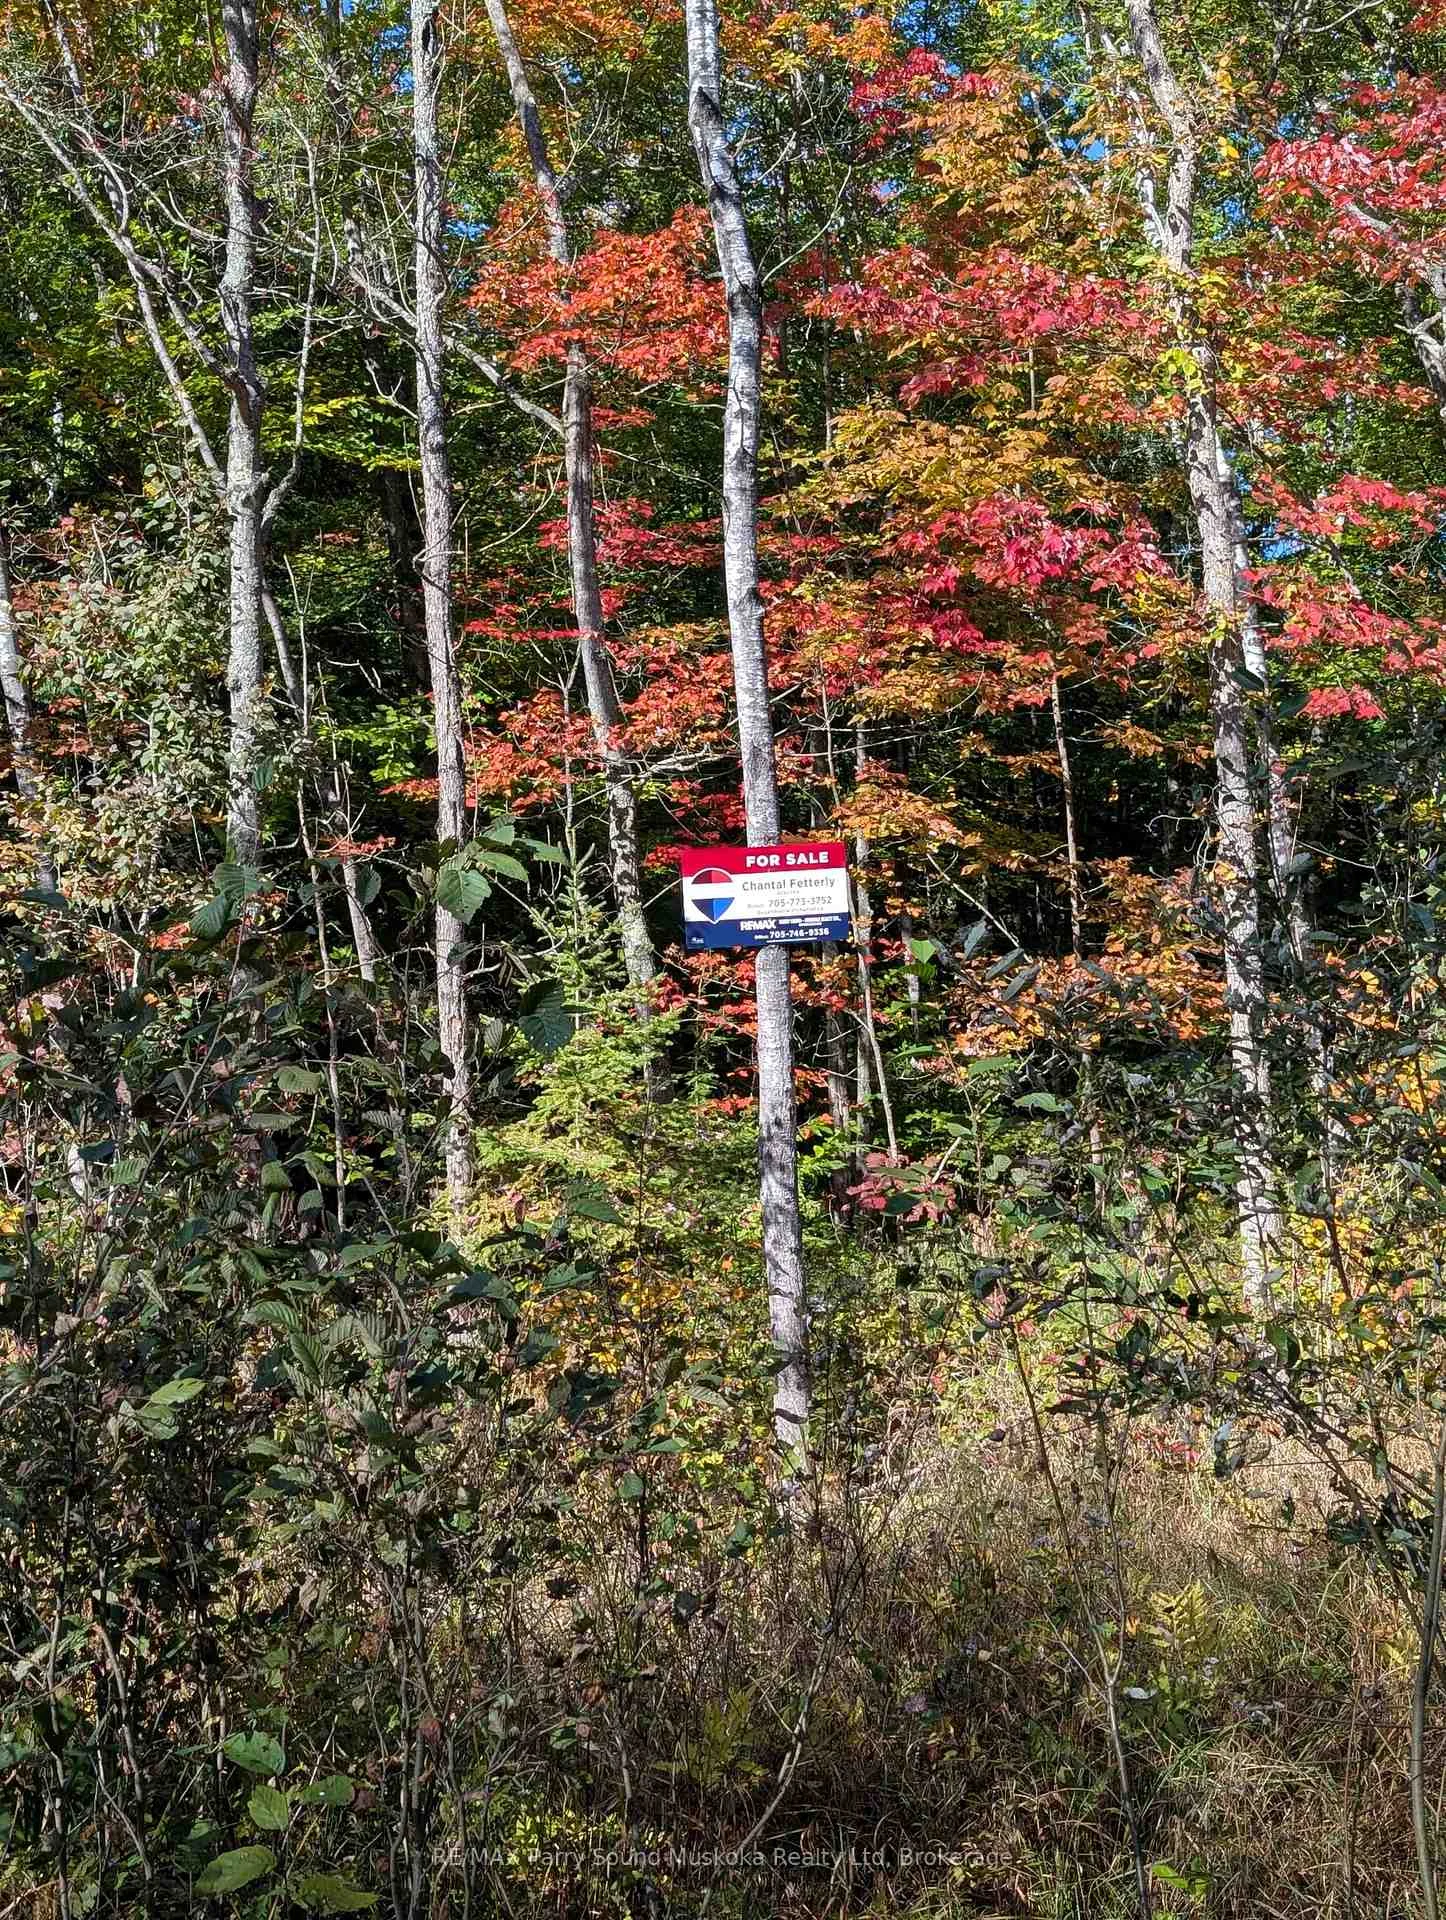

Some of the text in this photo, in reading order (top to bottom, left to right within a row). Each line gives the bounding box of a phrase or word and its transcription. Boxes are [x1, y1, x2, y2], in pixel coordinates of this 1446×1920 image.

[745, 851, 829, 868] FOR SALE
[742, 879, 786, 892] Chantal
[790, 876, 836, 890] Fetterly
